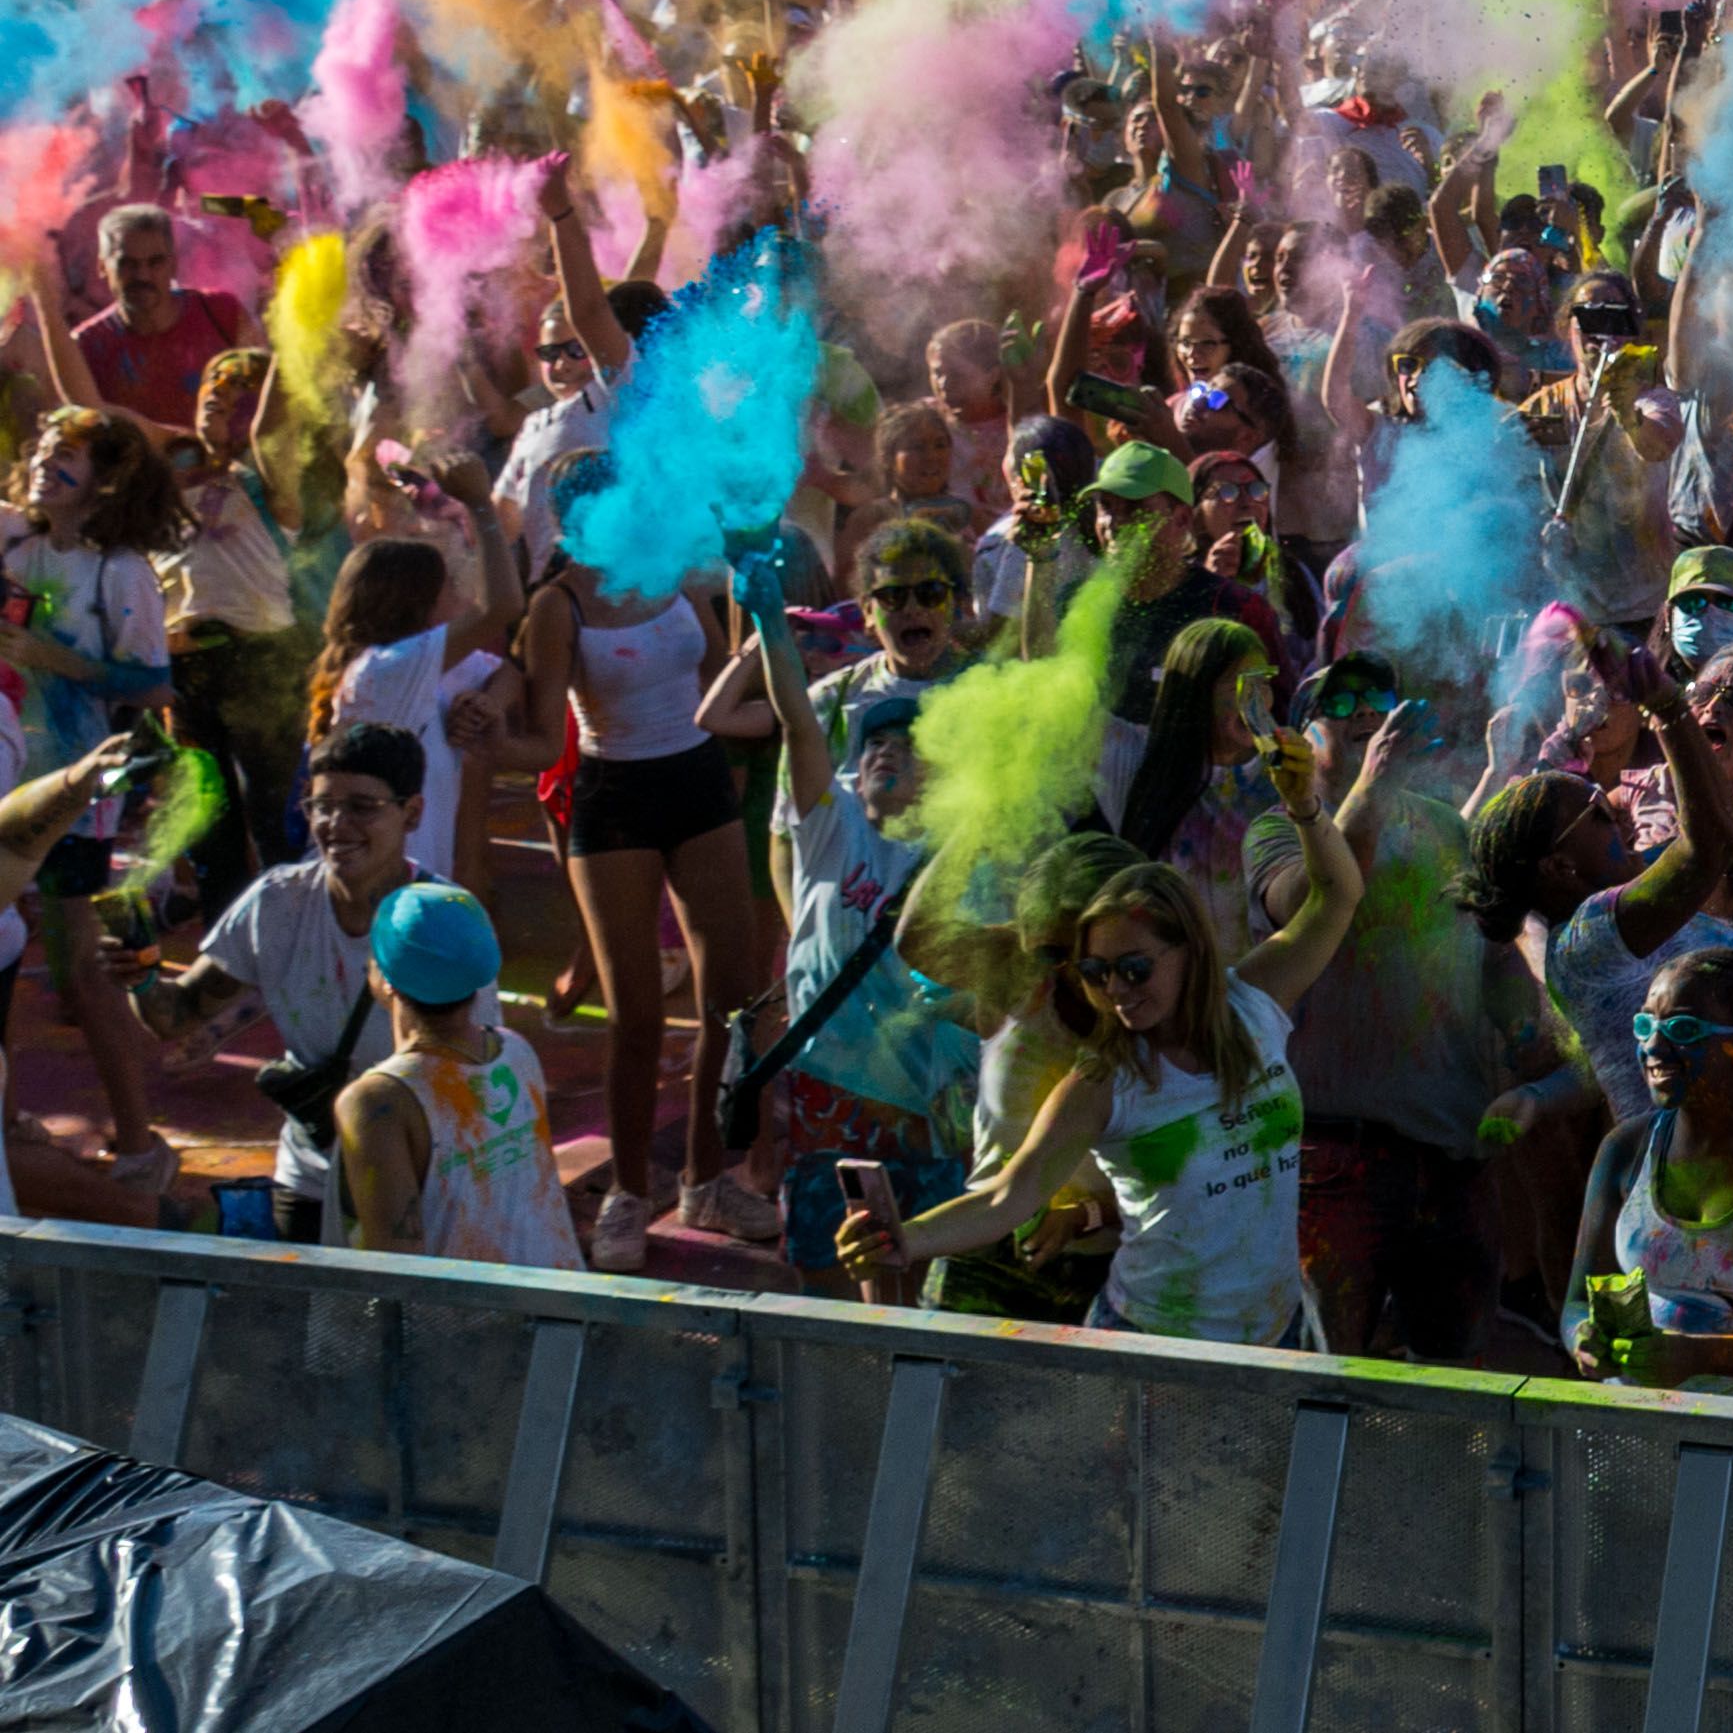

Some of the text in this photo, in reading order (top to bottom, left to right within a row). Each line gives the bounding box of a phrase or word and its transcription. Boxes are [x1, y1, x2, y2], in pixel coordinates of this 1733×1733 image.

[1223, 1142, 1250, 1161] no
[1205, 1180, 1228, 1198] lo
[1233, 1164, 1272, 1190] que
